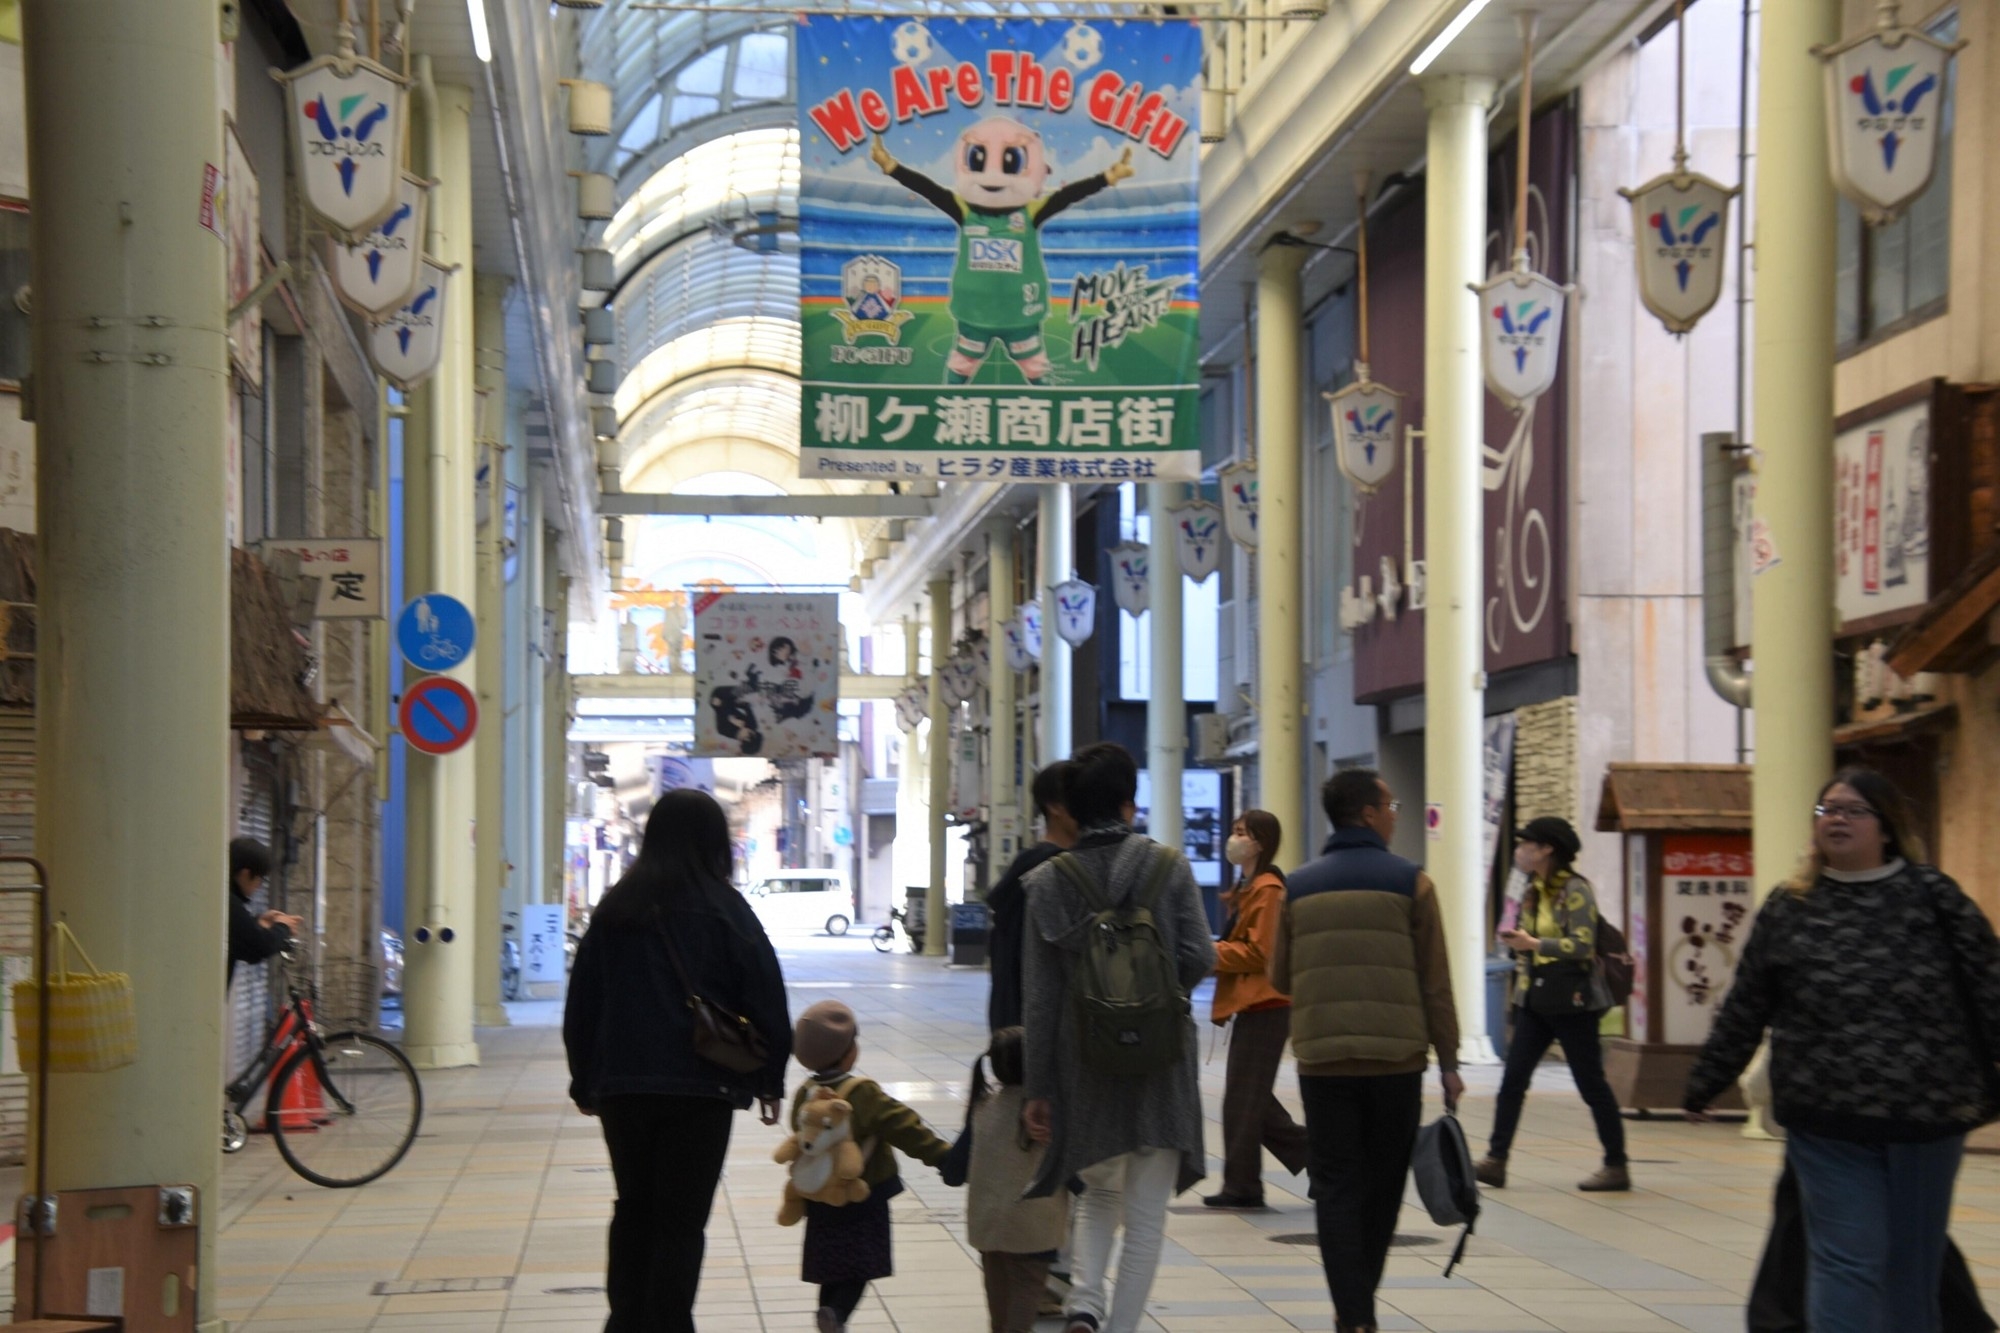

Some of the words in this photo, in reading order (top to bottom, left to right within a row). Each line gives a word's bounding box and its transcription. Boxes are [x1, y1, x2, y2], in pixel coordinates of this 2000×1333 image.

[809, 88, 890, 151] We
[892, 63, 982, 121] Are
[988, 50, 1073, 111] The
[1087, 70, 1187, 158] Gifu
[307, 140, 385, 156] フローレンス
[1070, 261, 1148, 319] MOVE
[859, 345, 914, 365] GIFU
[818, 457, 897, 475] Presented
[904, 460, 923, 476] by
[936, 456, 1157, 479] ヒラタ産業株式会社
[330, 570, 366, 601] 定
